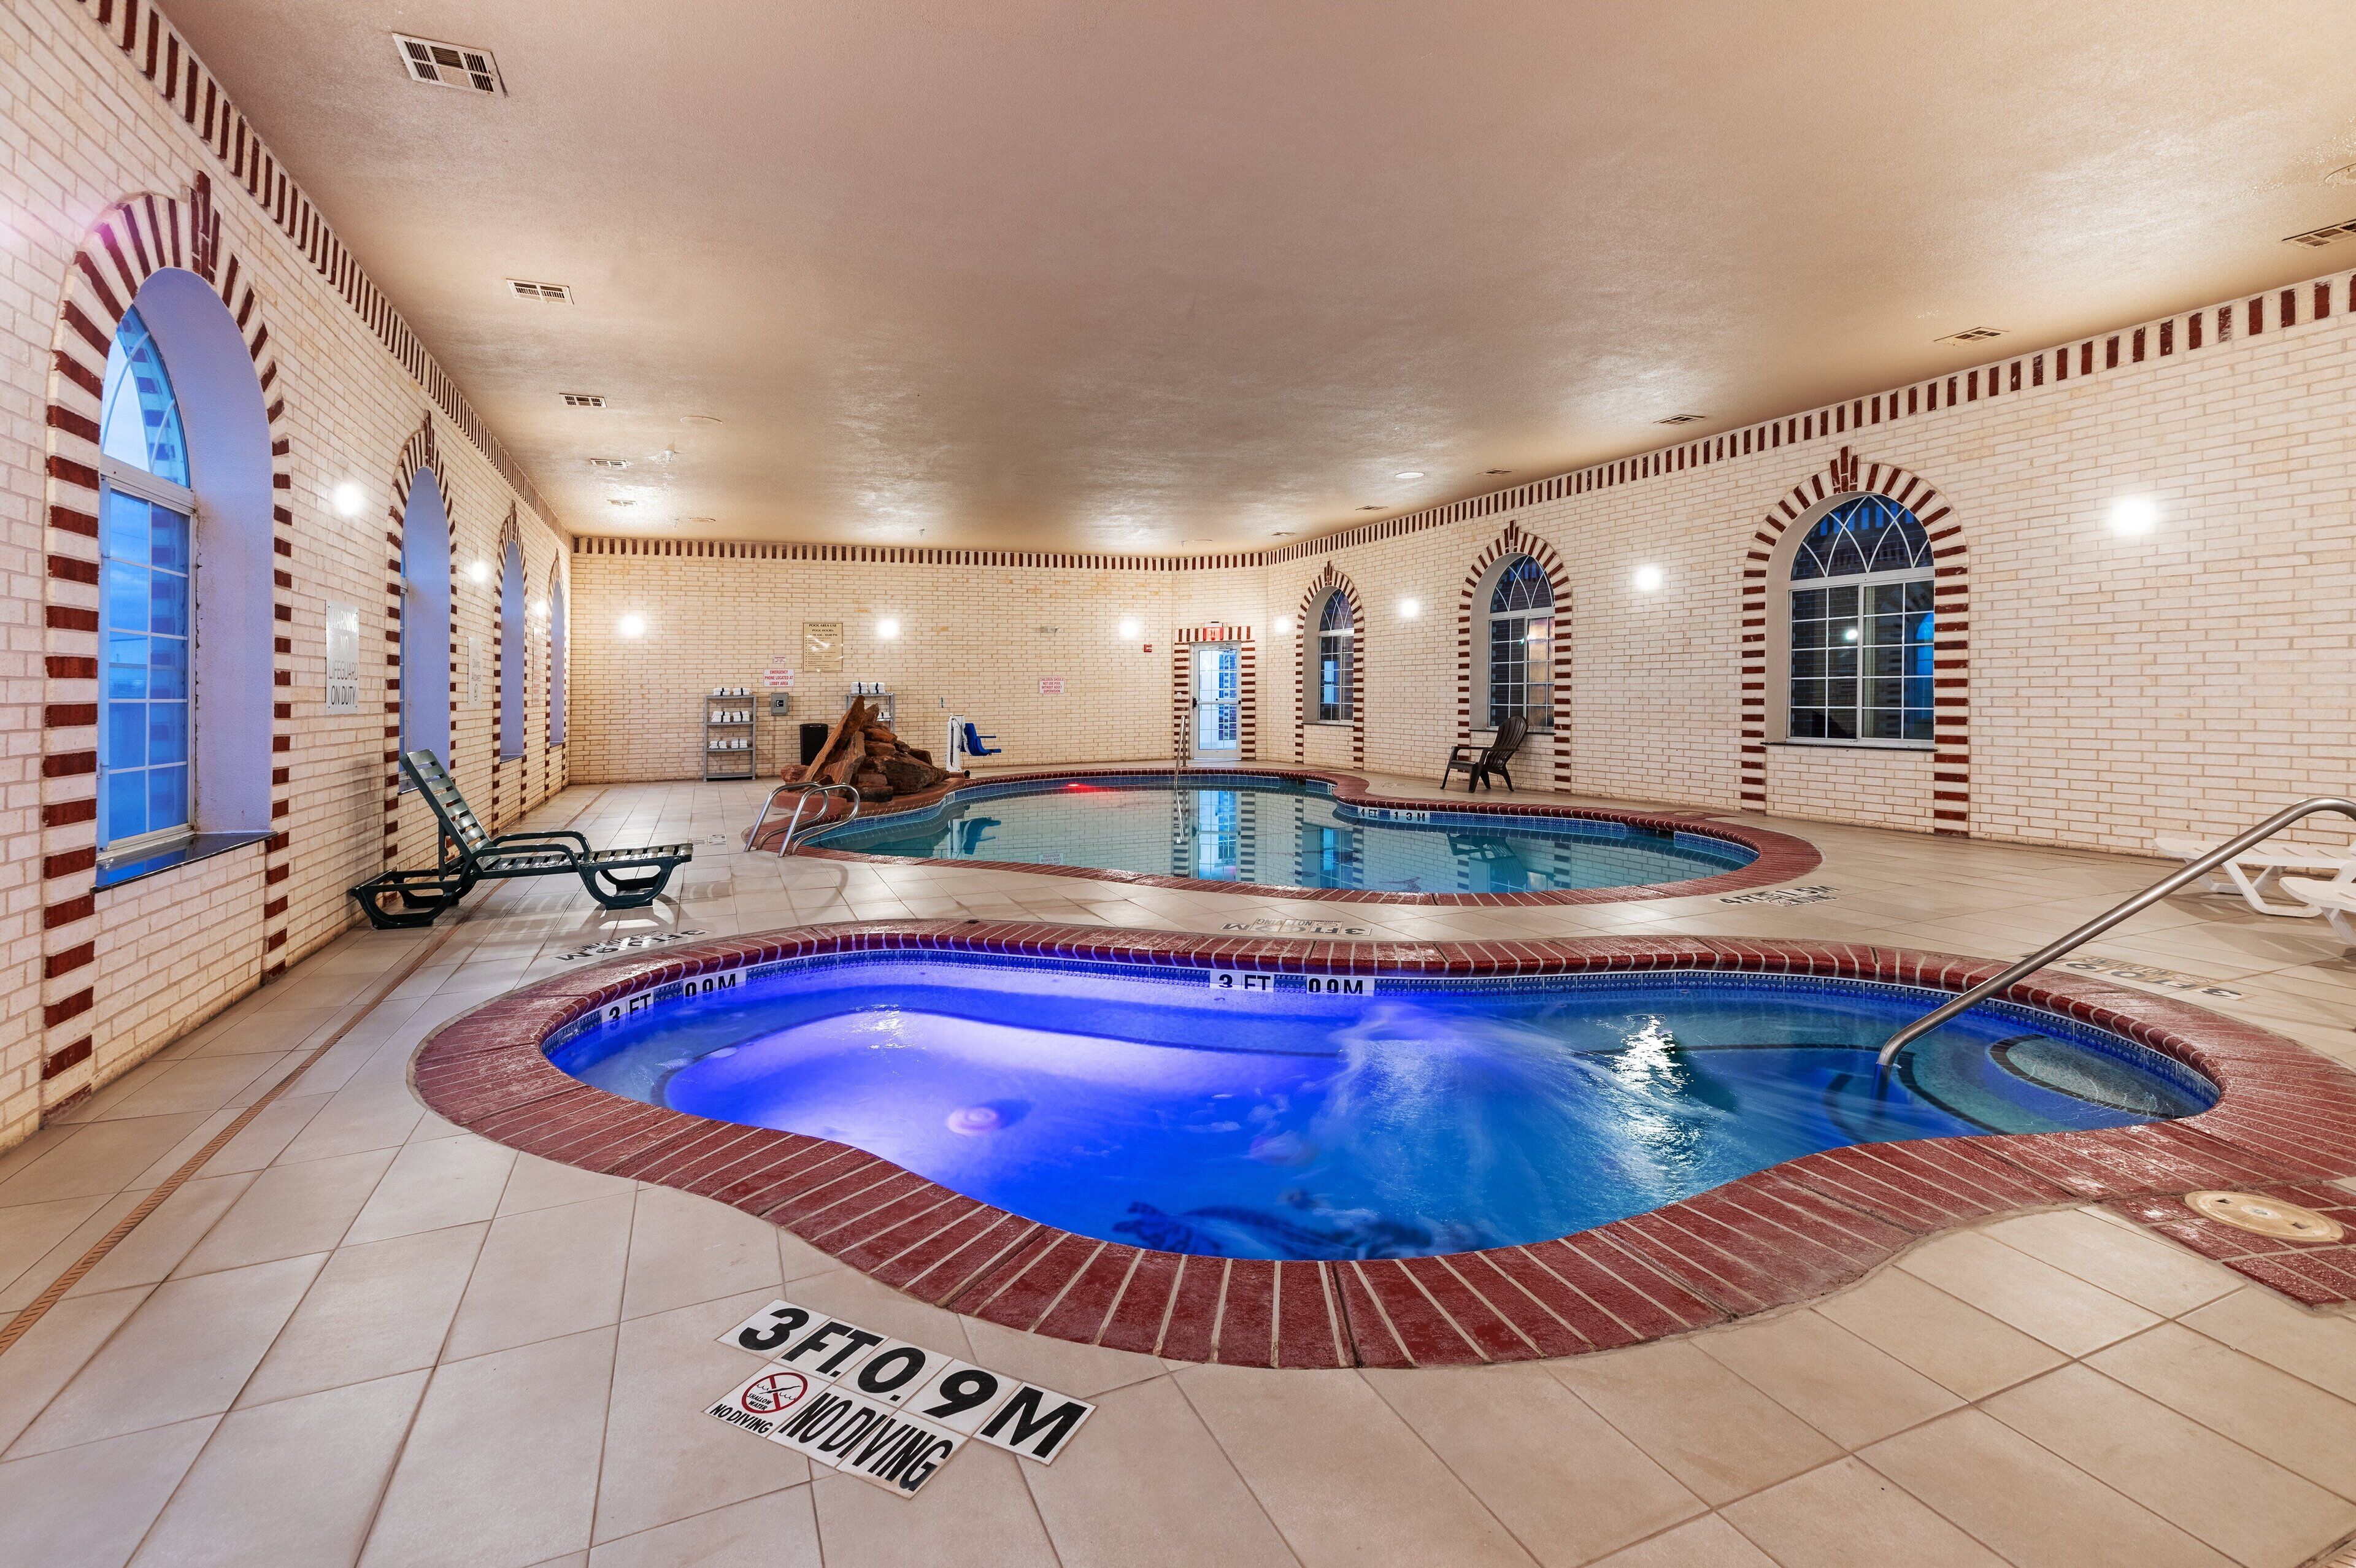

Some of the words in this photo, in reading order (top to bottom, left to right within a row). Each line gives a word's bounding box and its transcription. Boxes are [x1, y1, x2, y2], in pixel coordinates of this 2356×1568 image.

[330, 608, 356, 633] WARNING
[341, 634, 349, 655] NO
[329, 658, 358, 681] LIFEGUARD
[331, 685, 340, 705] ON
[341, 685, 356, 705] DUTY
[555, 951, 593, 961] M
[2144, 966, 2170, 976] NO
[629, 993, 652, 1016] FT
[717, 973, 736, 991] M
[1218, 973, 1233, 988] 3
[1244, 974, 1271, 991] FT
[1343, 979, 1363, 995] M
[2201, 988, 2242, 997] 3
[738, 1307, 809, 1351] 3
[780, 1321, 885, 1378] FT.
[980, 1386, 1088, 1459] M
[747, 1393, 773, 1405] SHALLOW
[748, 1400, 768, 1411] WATER
[709, 1403, 733, 1418] NO
[726, 1410, 774, 1434] DIVING
[777, 1392, 853, 1443] NO
[817, 1407, 953, 1492] DIVING
